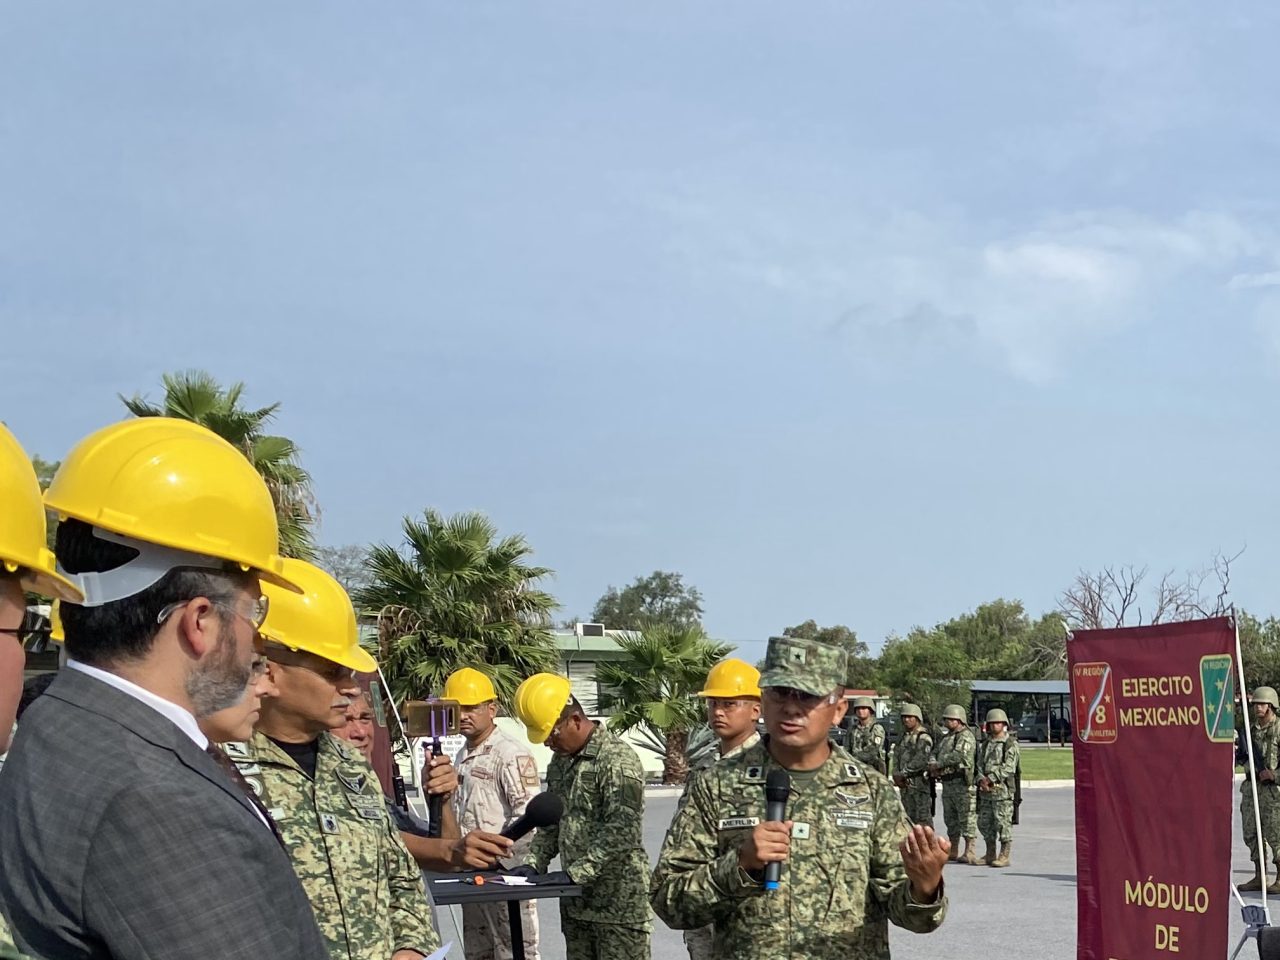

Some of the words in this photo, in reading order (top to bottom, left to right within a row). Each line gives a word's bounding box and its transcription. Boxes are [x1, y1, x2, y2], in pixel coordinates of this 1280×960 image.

[1122, 676, 1193, 697] EJERCITO
[1095, 705, 1106, 724] 8
[1119, 706, 1201, 726] MEXICANO
[722, 818, 756, 827] MERLIN
[1125, 875, 1209, 914] MÓDULO
[1155, 924, 1179, 952] DE
